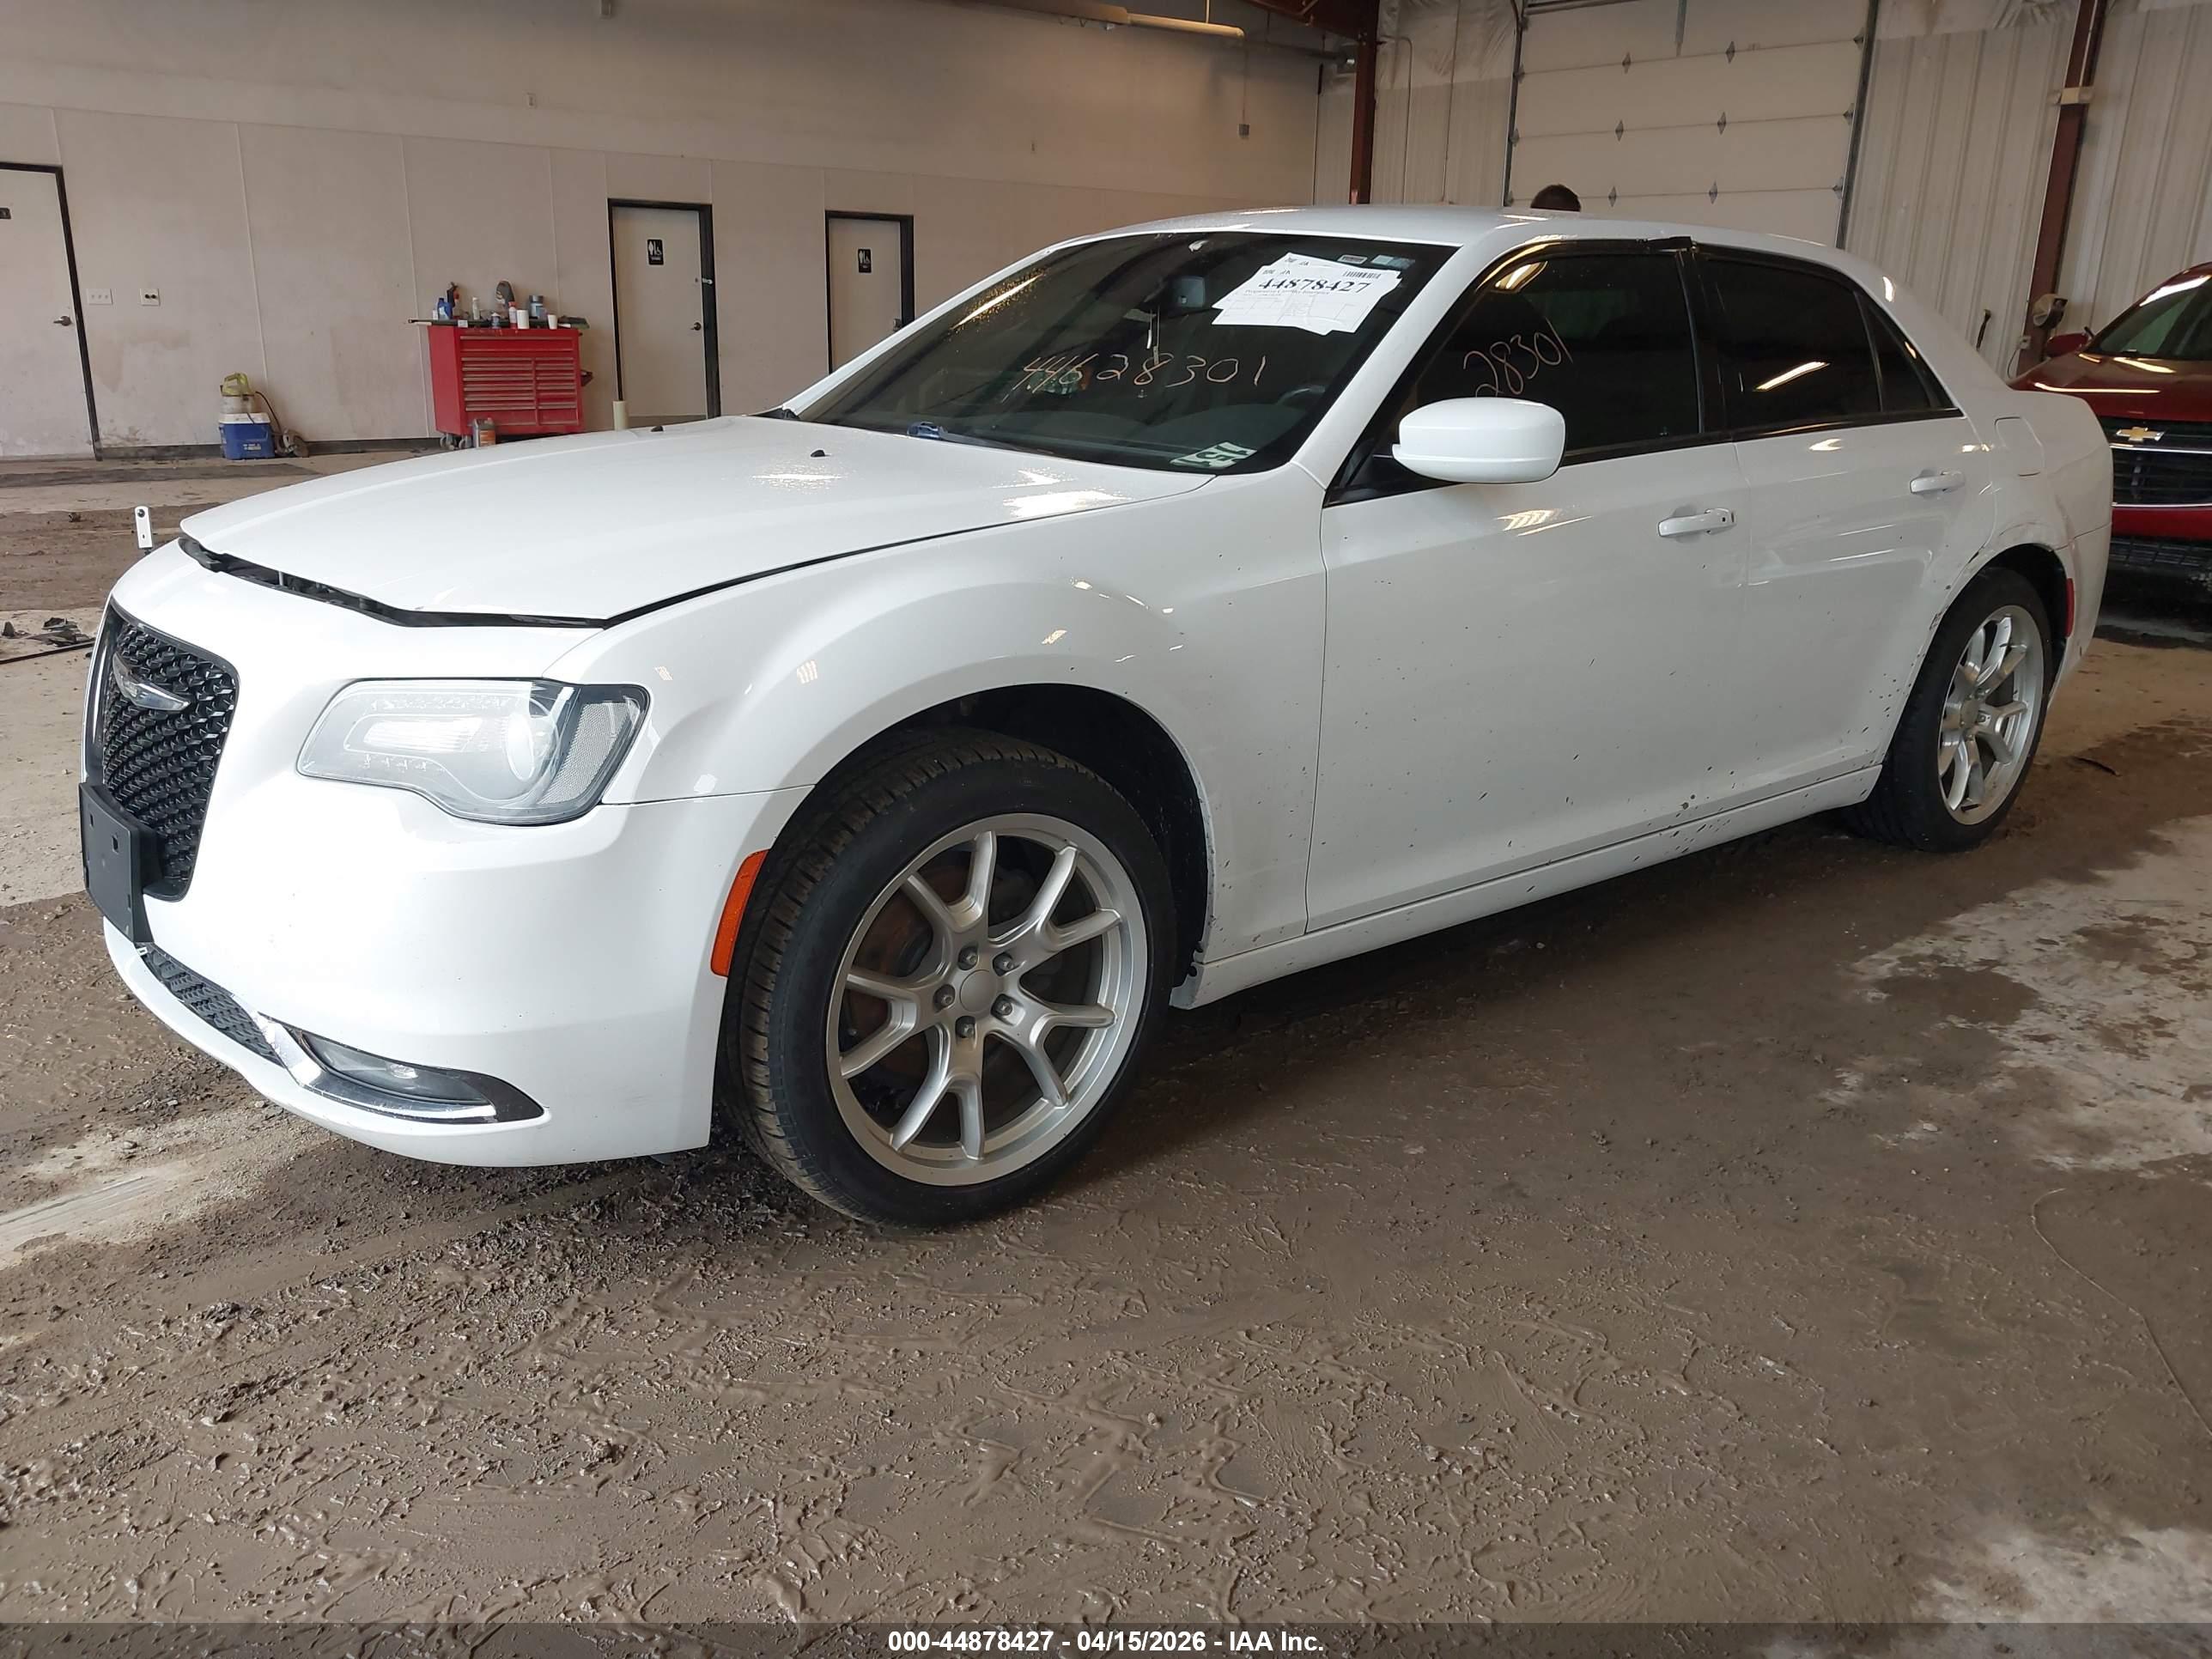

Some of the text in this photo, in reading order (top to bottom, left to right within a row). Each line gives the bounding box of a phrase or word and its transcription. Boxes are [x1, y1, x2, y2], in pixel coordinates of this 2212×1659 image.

[1258, 277, 1371, 294] 44878427
[1000, 353, 1267, 404] 44628301
[1463, 316, 1573, 398] 28301
